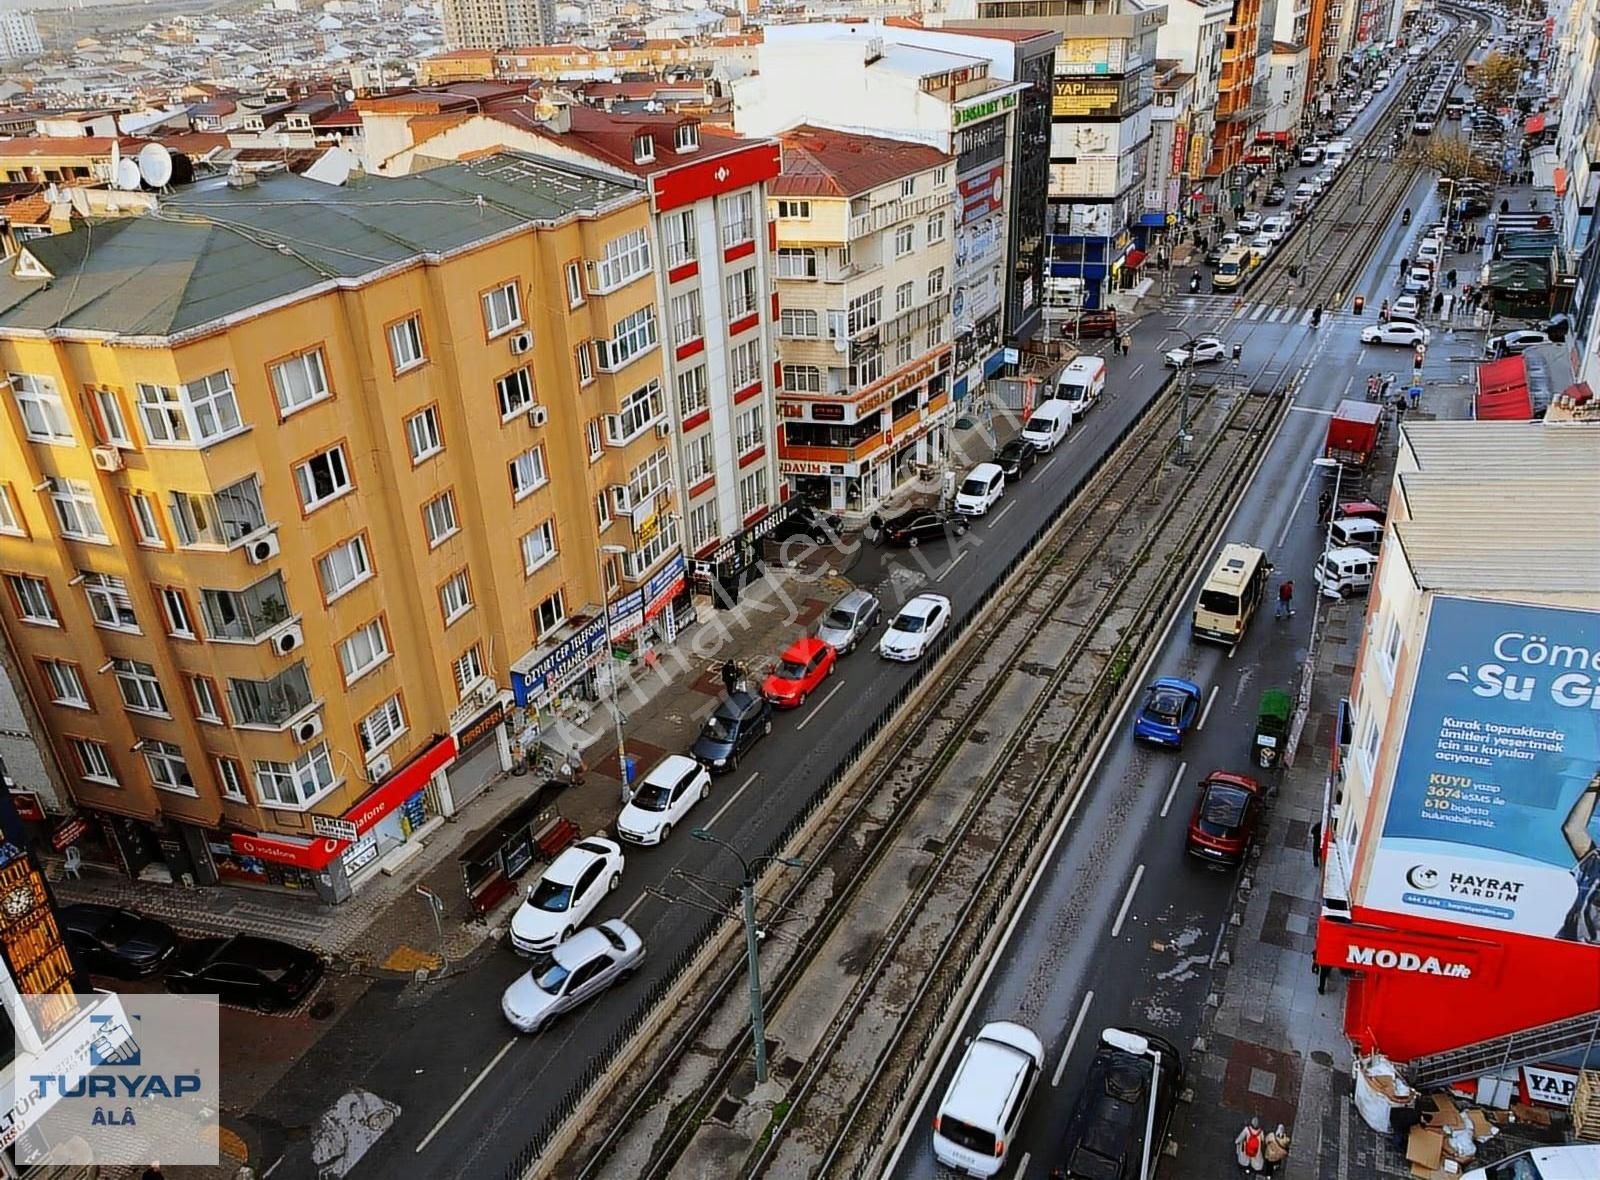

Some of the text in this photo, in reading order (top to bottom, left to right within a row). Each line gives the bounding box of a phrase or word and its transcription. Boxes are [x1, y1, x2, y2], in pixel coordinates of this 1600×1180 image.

[1056, 83, 1085, 95] YAPI
[1472, 664, 1536, 701] Su
[1442, 717, 1565, 741] Kurak topraklarda
[1440, 728, 1565, 752] ümitleri yeşertmek
[1435, 751, 1493, 766] açıyoruz.
[1464, 744, 1478, 752] su
[1481, 744, 1535, 760] kuyuları
[1429, 773, 1472, 788] KUYU
[1450, 873, 1524, 893] HAYRAT
[1449, 885, 1518, 902] YARDIM
